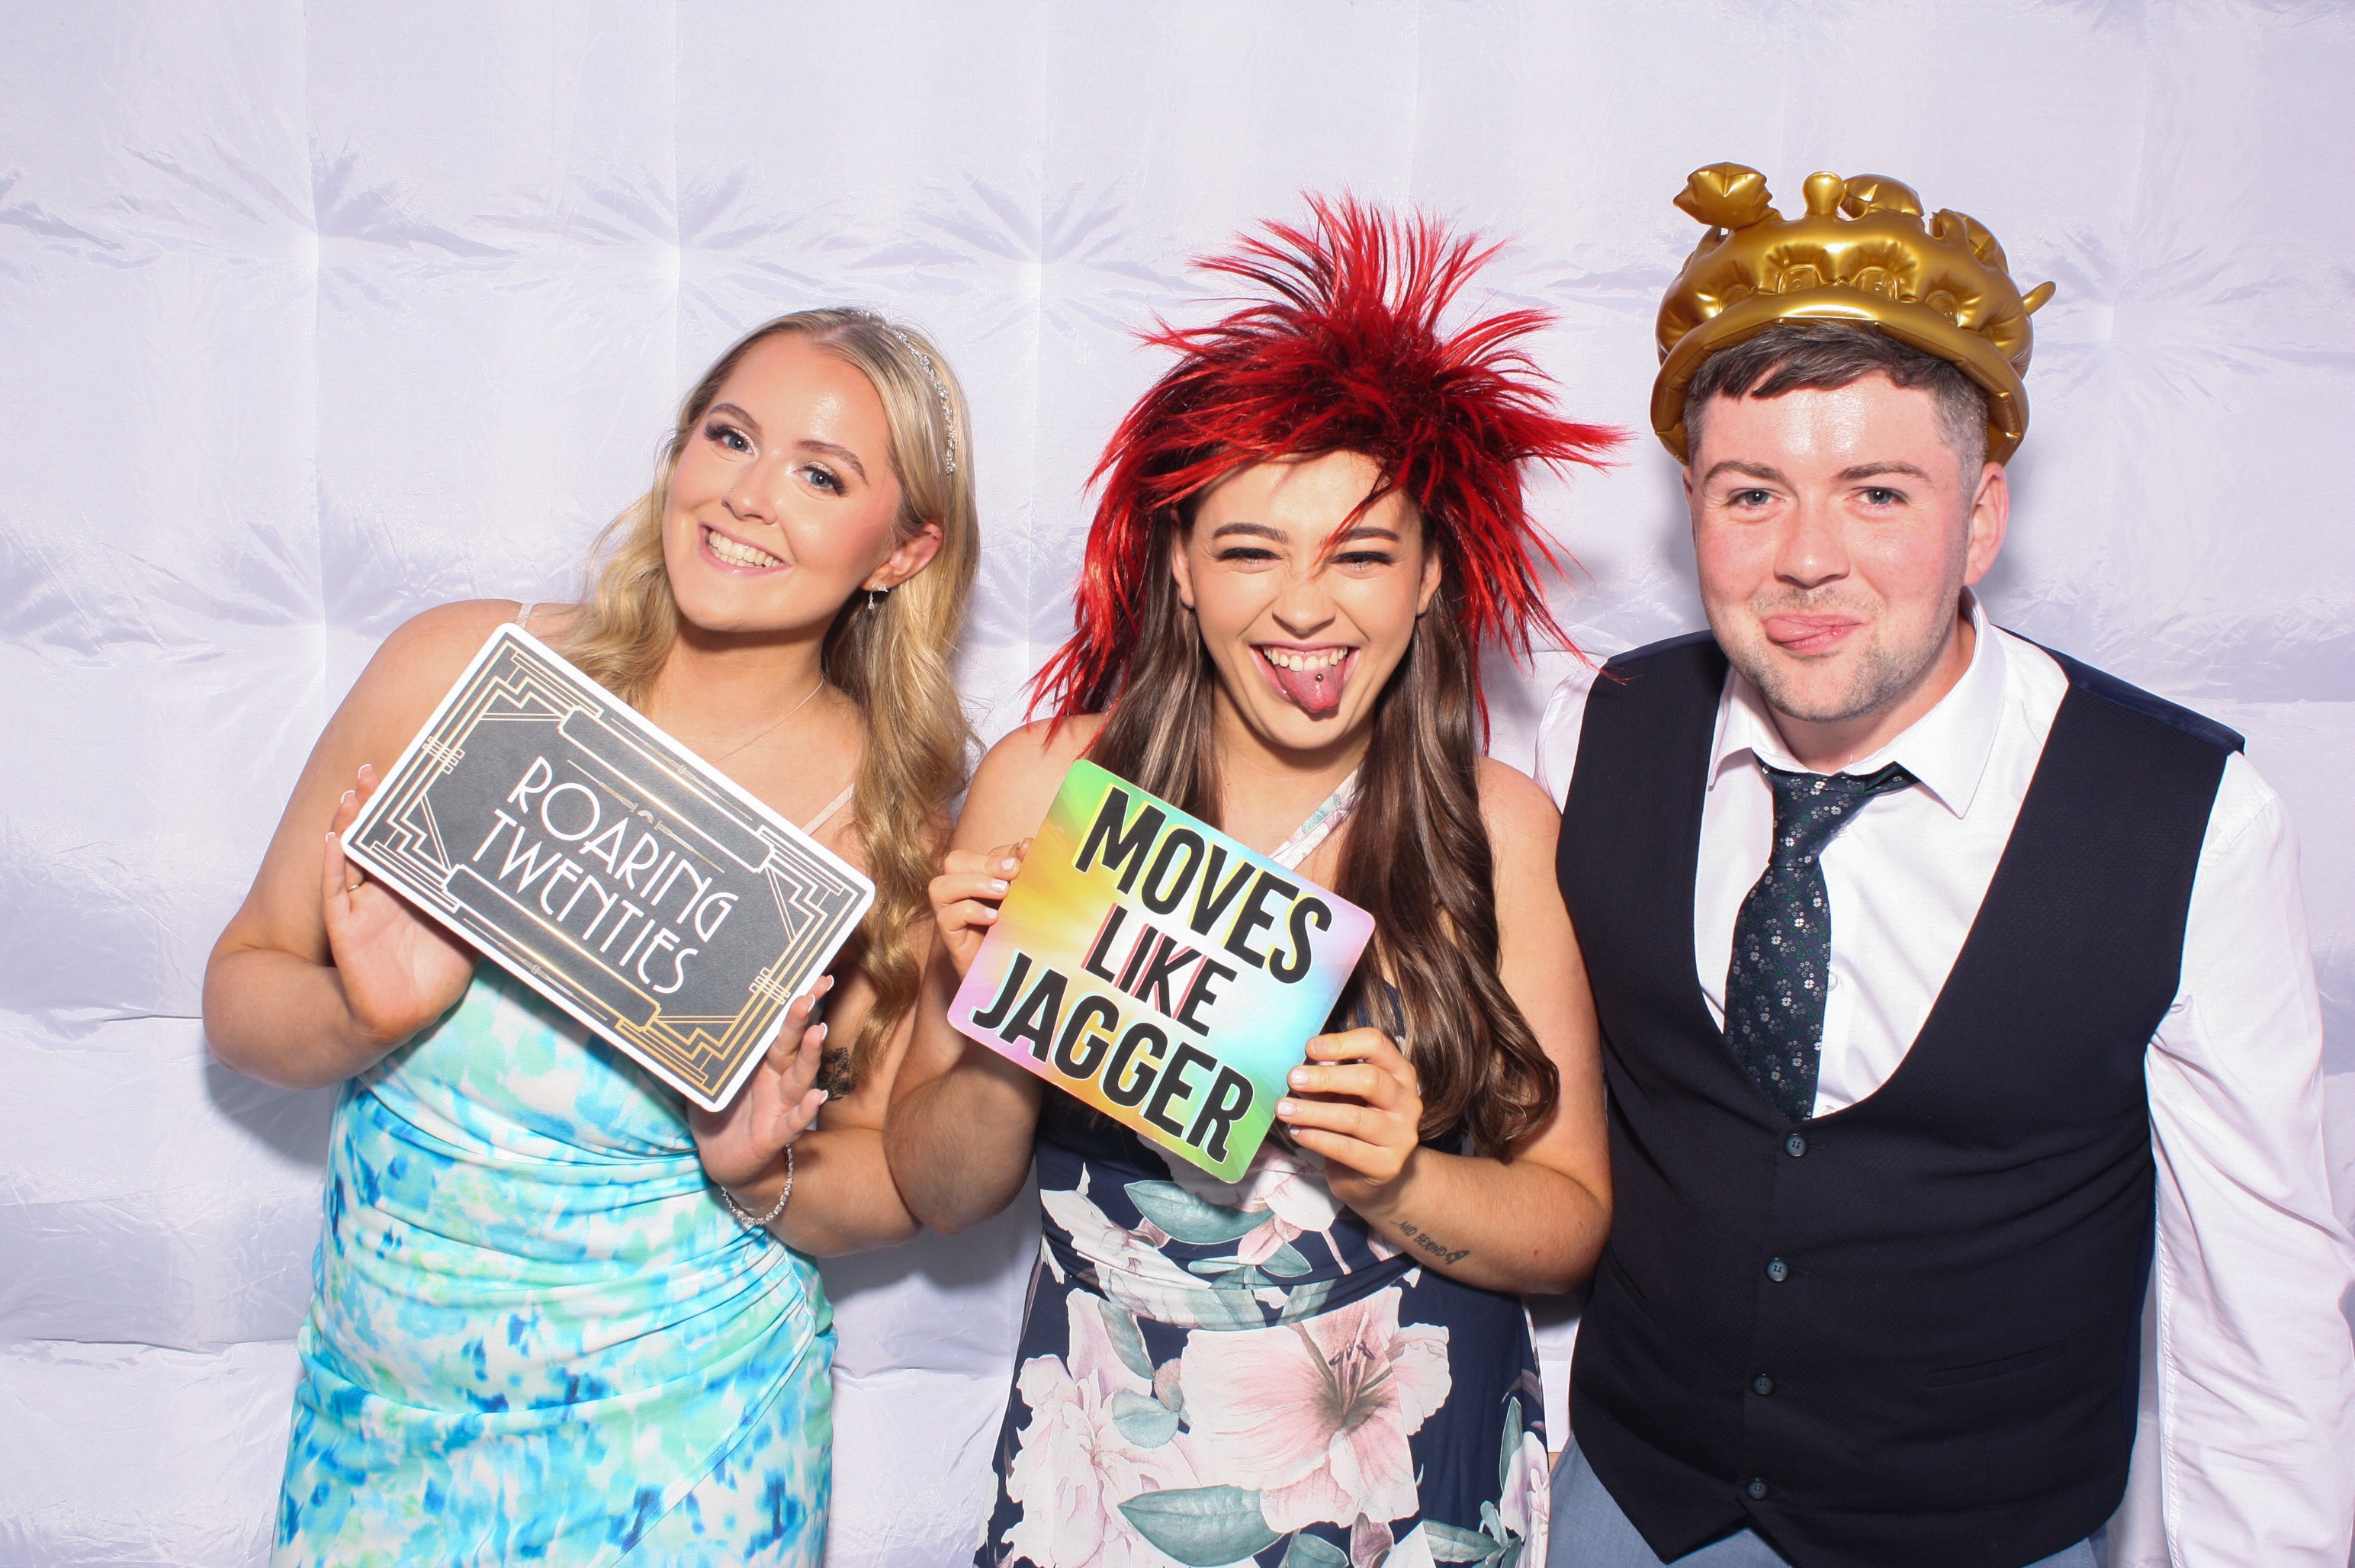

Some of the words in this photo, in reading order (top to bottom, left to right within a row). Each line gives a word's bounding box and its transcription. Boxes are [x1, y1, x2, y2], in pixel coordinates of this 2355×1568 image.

[472, 808, 699, 994] TWENTIES
[506, 756, 739, 943] ROARING
[1072, 783, 1332, 984] MOVES
[969, 949, 1254, 1163] JAGGER
[1081, 902, 1238, 1037] LIKE
[1414, 1233, 1447, 1256] BEYOND
